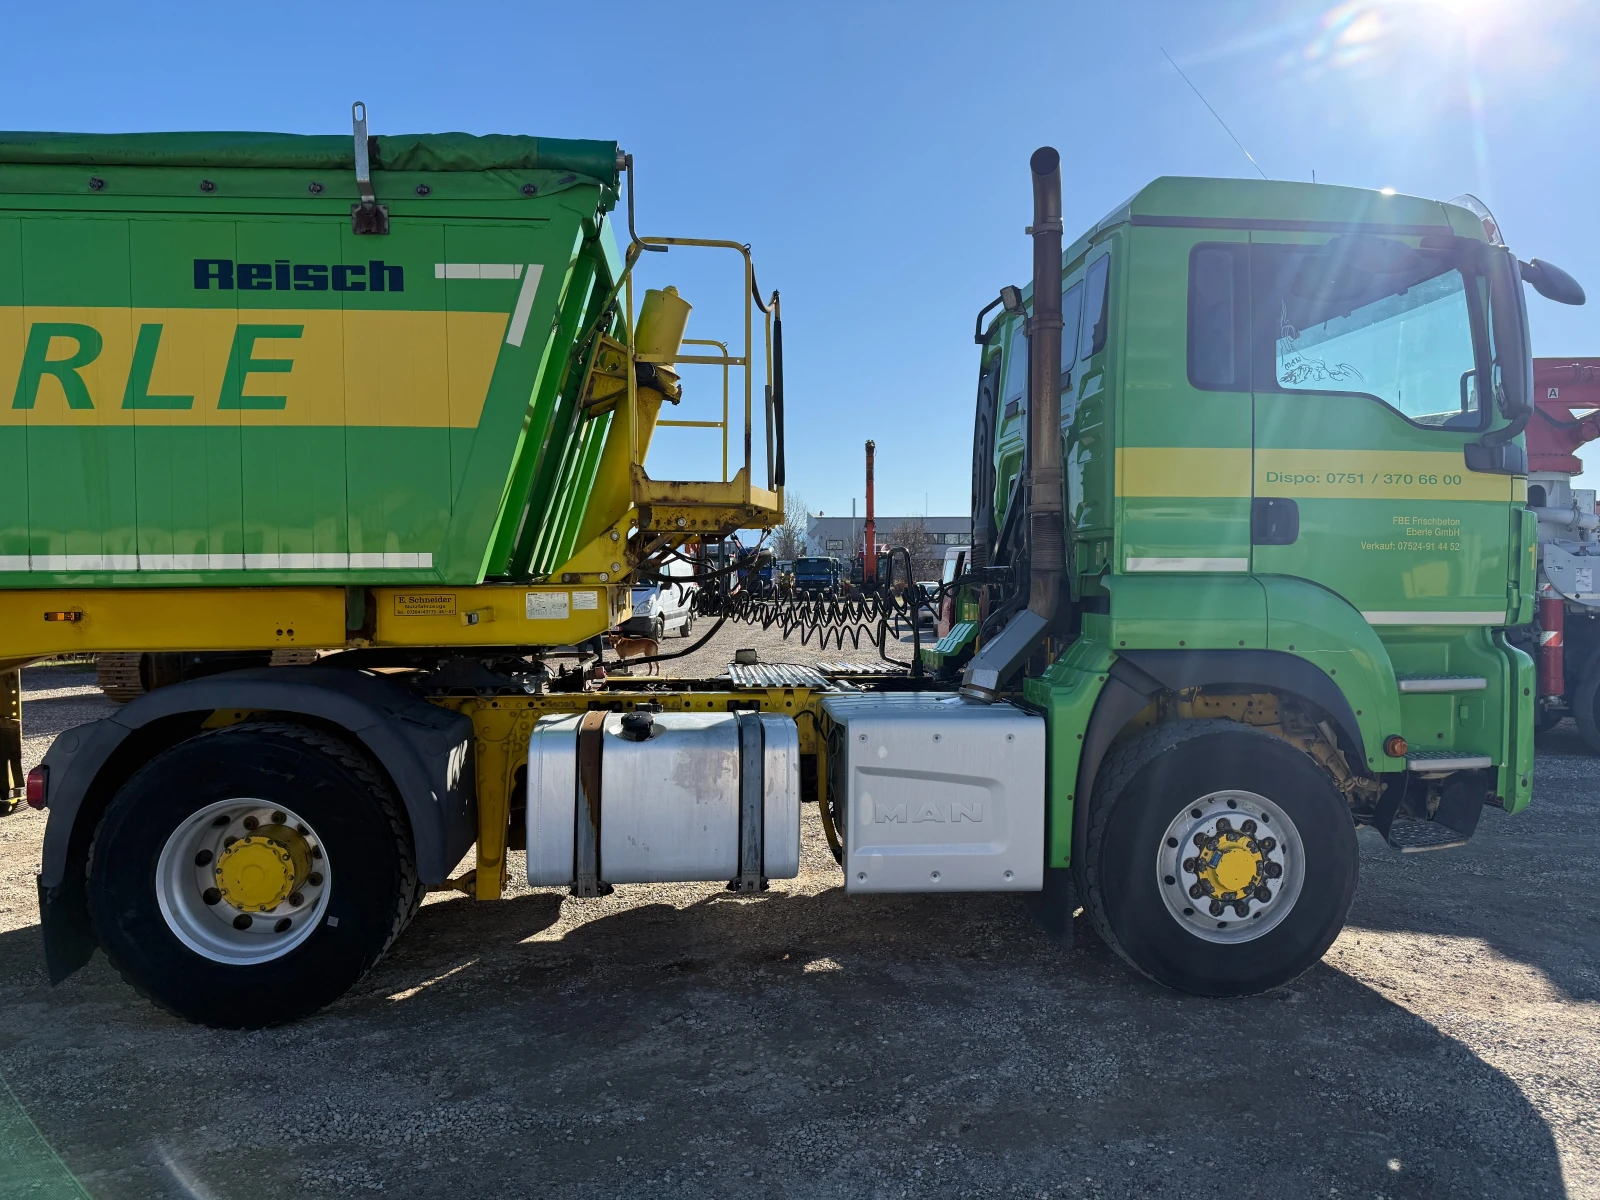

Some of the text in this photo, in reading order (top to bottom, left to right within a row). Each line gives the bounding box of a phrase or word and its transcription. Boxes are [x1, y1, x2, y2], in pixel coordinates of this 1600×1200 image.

[193, 258, 404, 292] Reisch
[1548, 388, 1558, 398] A
[1266, 471, 1462, 486] Dispo: 0751 / 370 66 00
[1392, 516, 1460, 526] FBE Frischbeton
[1406, 527, 1460, 537] Eberle GmbH
[1360, 541, 1460, 551] Verkauf: 07524-91 44 52
[398, 595, 452, 604] E. Schneider
[875, 802, 983, 824] MAN
